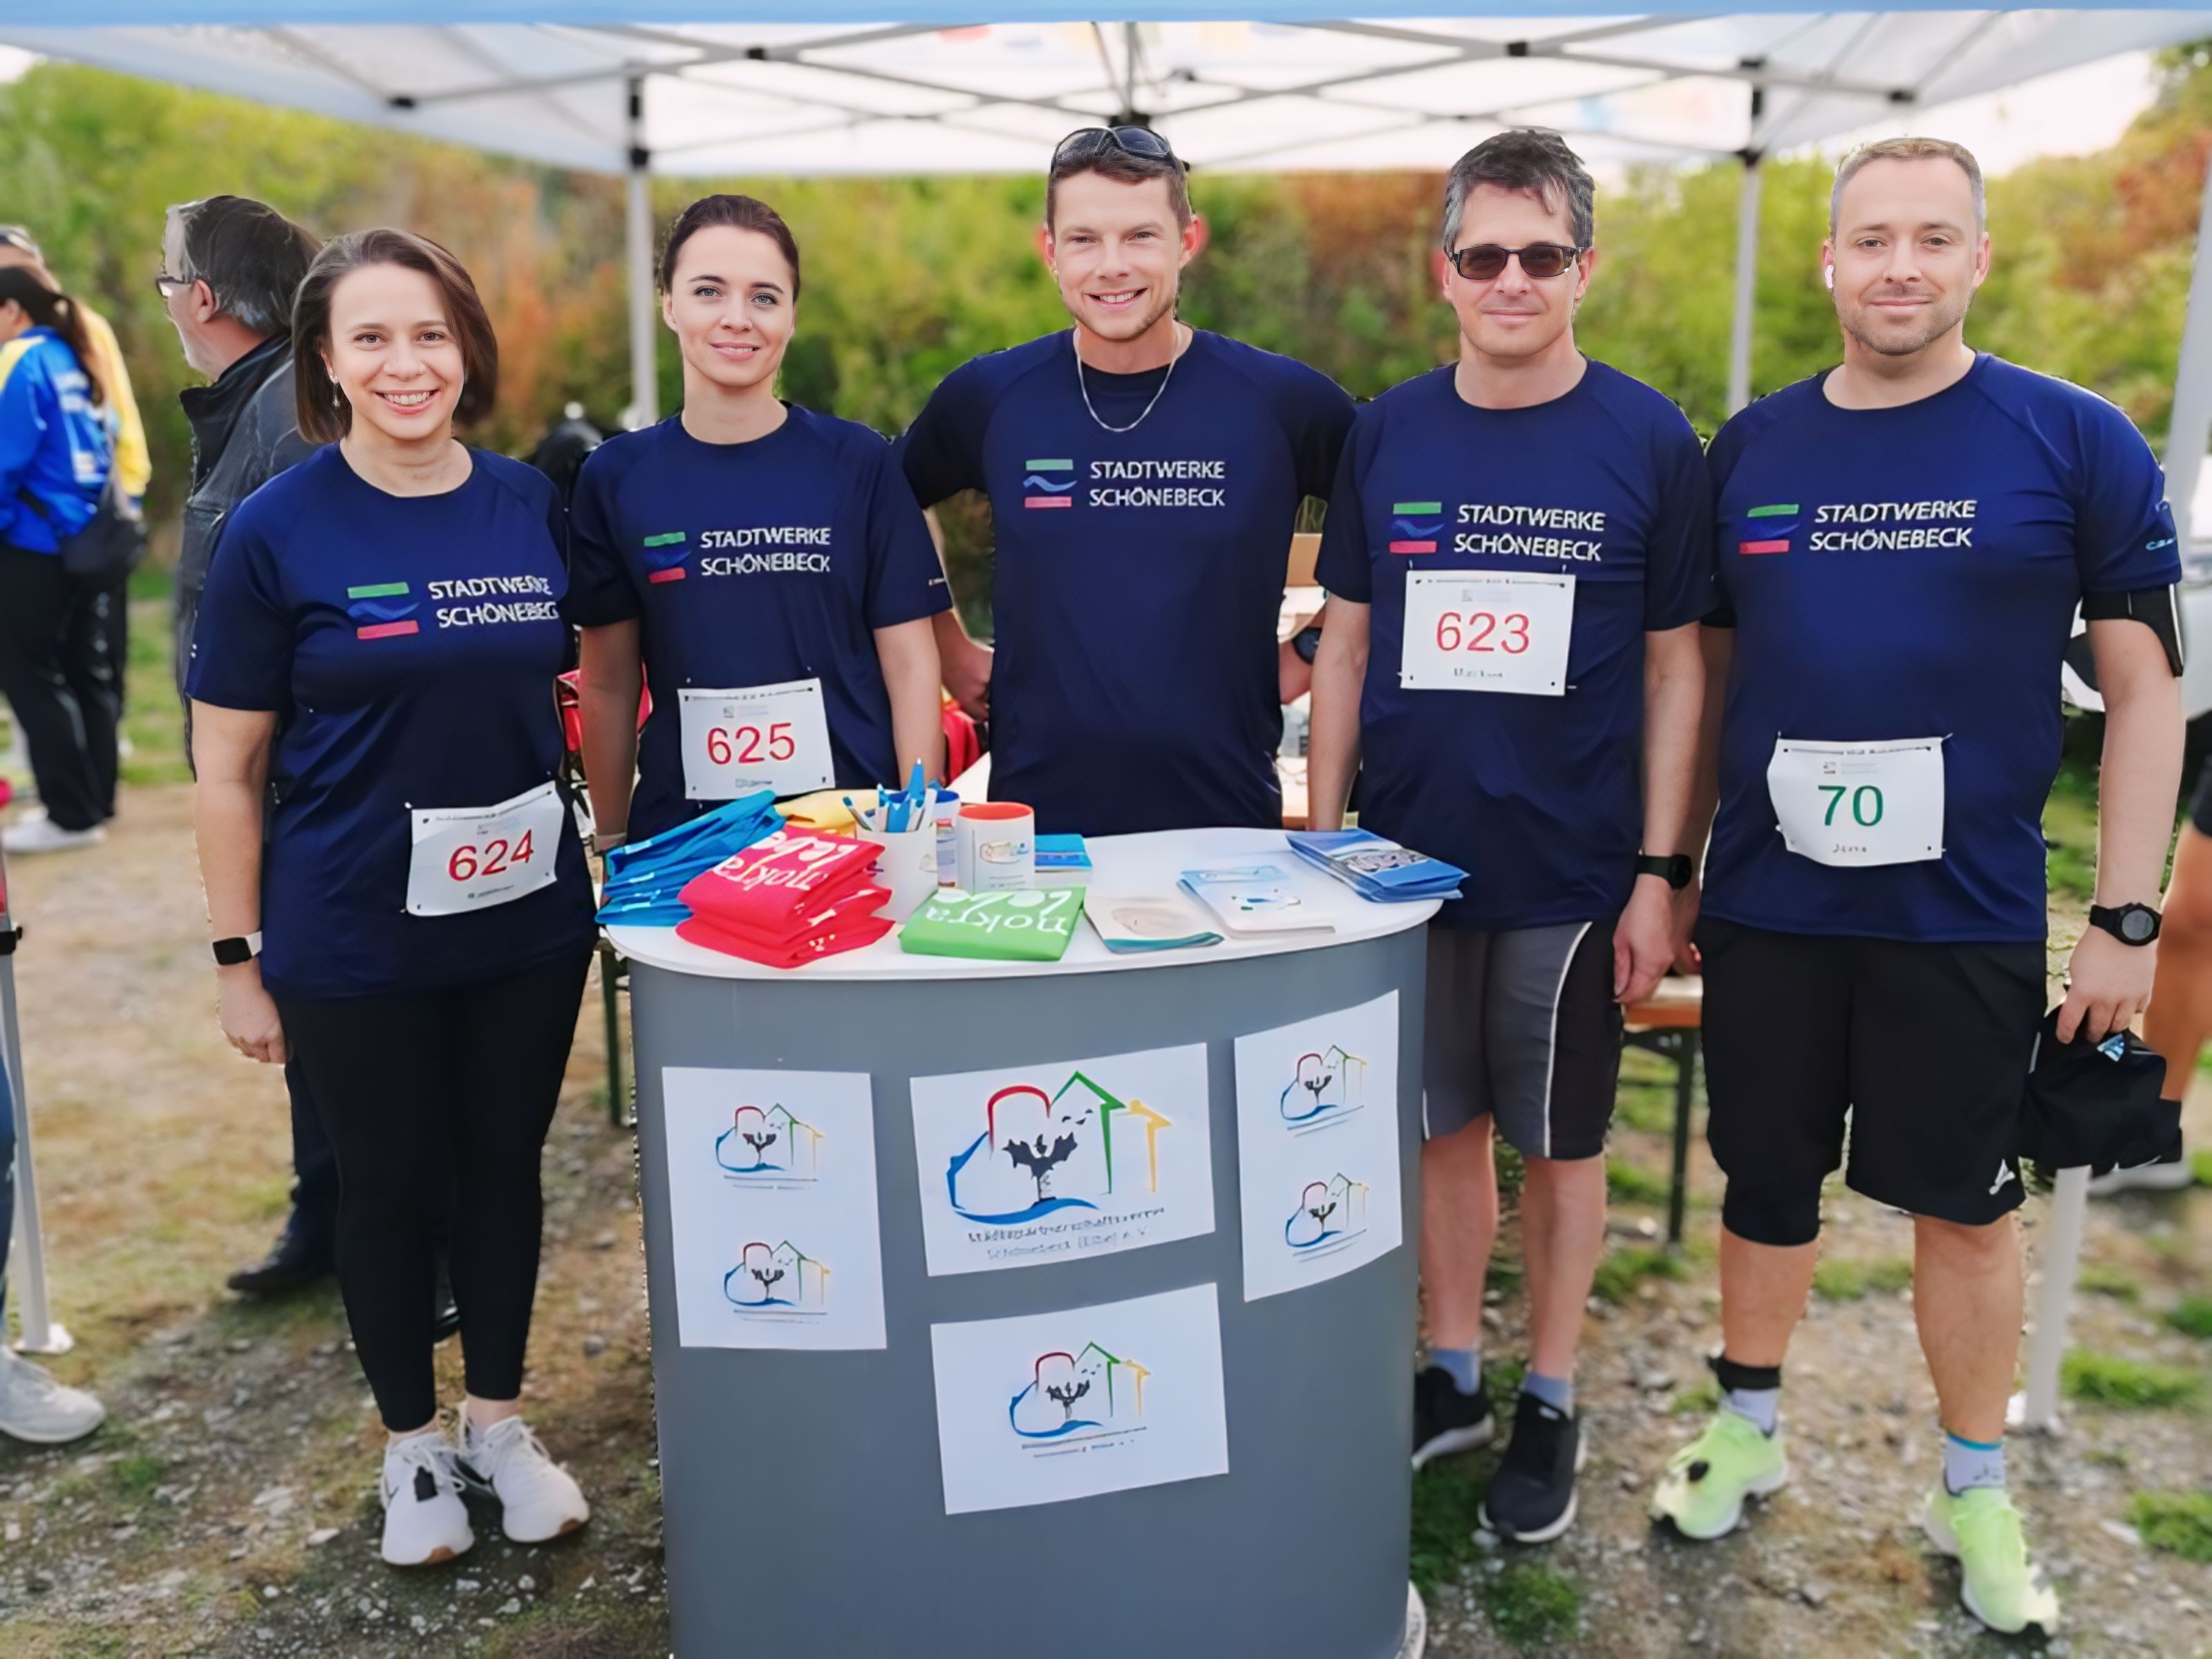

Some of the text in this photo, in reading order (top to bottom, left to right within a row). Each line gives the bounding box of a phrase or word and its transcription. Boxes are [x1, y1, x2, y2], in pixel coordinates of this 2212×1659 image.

[1090, 460, 1226, 479] STADTWERKE
[1089, 486, 1226, 507] SCHÖNEBECK
[1457, 504, 1606, 532] STADTWERKE
[1814, 500, 1978, 523] STADTWERKE
[700, 527, 831, 548] STADTWERKE
[1454, 533, 1602, 561] SCHÖNEBECK
[1808, 527, 1973, 551] SCHÖNEBECK
[700, 553, 830, 576] SCHÖNEBECK
[1436, 612, 1530, 655] 623
[707, 722, 796, 765] 625
[1818, 785, 1884, 827] 70
[449, 829, 534, 881] 624
